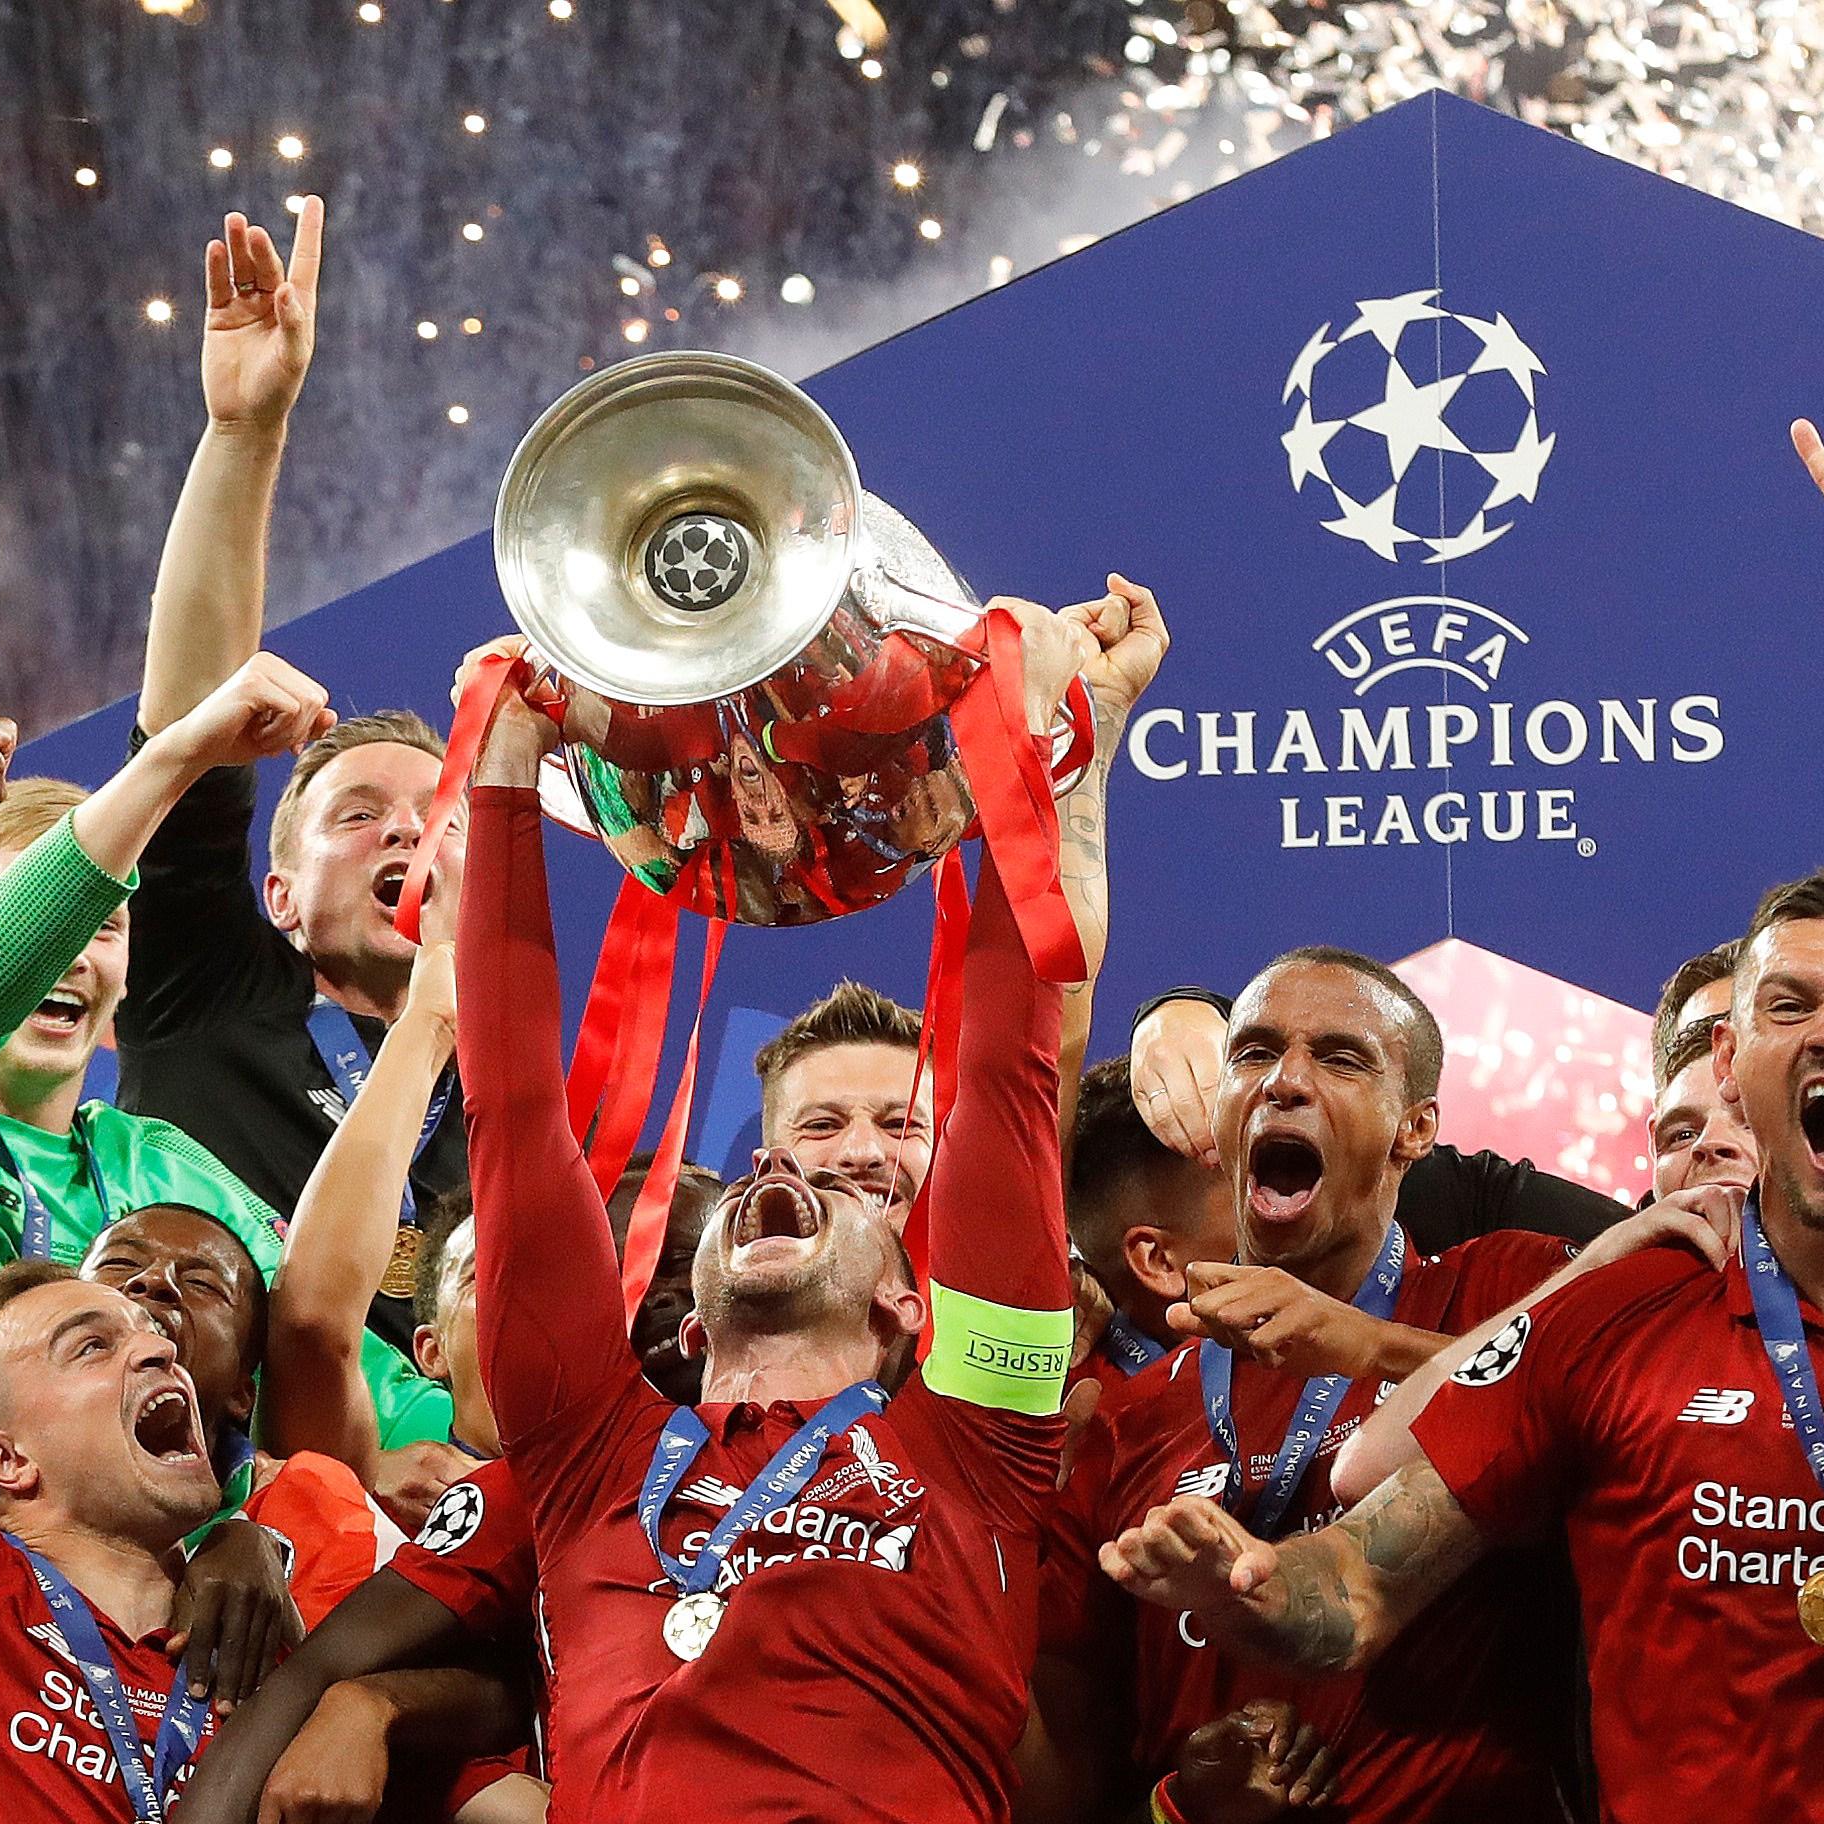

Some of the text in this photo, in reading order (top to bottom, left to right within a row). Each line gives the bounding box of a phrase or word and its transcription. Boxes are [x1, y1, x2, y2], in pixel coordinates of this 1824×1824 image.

[1325, 610, 1509, 681] UEFA
[1127, 694, 1725, 782] CHAMPIONS
[1279, 788, 1577, 849] LEAGUE
[965, 1338, 1064, 1374] RESPECT
[801, 1476, 835, 1503] ADRID
